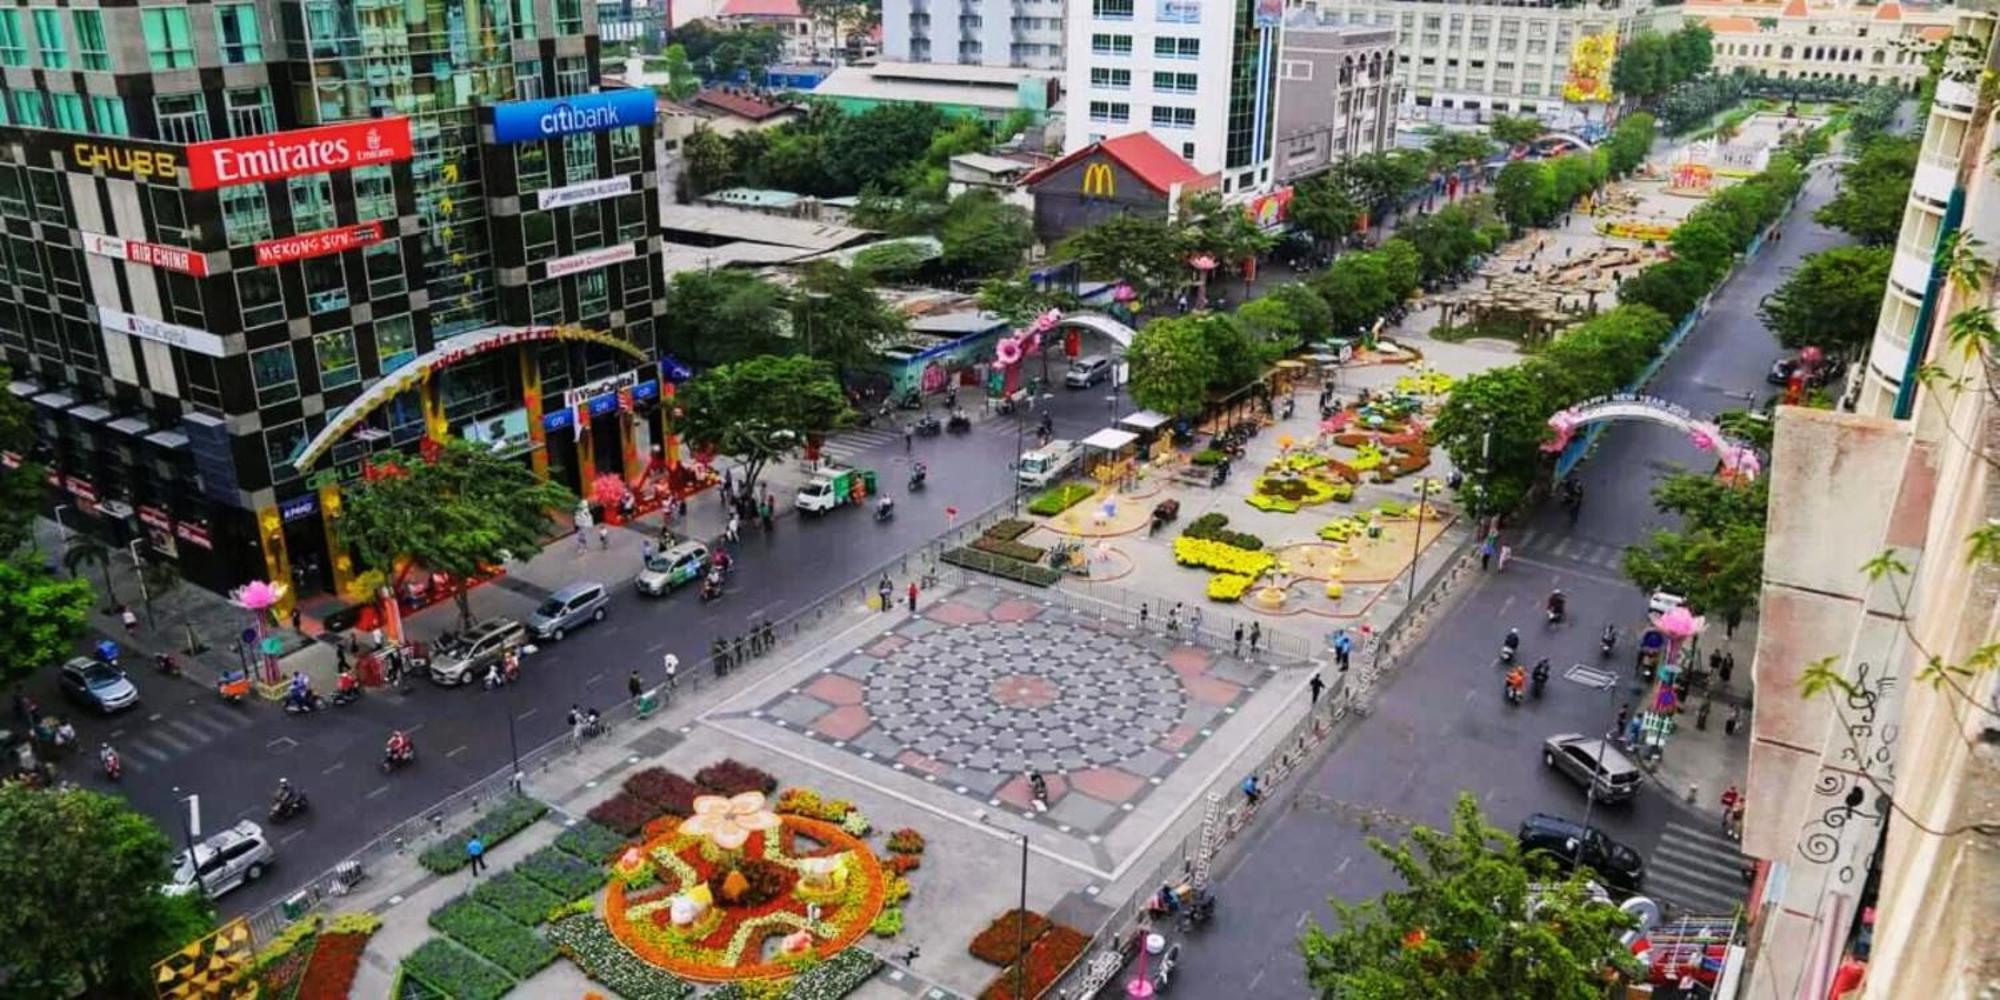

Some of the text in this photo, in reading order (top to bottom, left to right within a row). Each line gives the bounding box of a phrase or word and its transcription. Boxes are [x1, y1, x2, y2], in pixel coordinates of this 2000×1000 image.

[541, 101, 620, 133] citibank
[74, 144, 177, 177] CHUBB
[213, 138, 350, 182] Emirates
[131, 243, 152, 263] AIR
[153, 247, 189, 272] CHINA
[259, 239, 318, 261] MEKONG
[321, 232, 349, 250] SUN
[1613, 393, 1635, 401] NEW
[1640, 394, 1666, 408] YEAR
